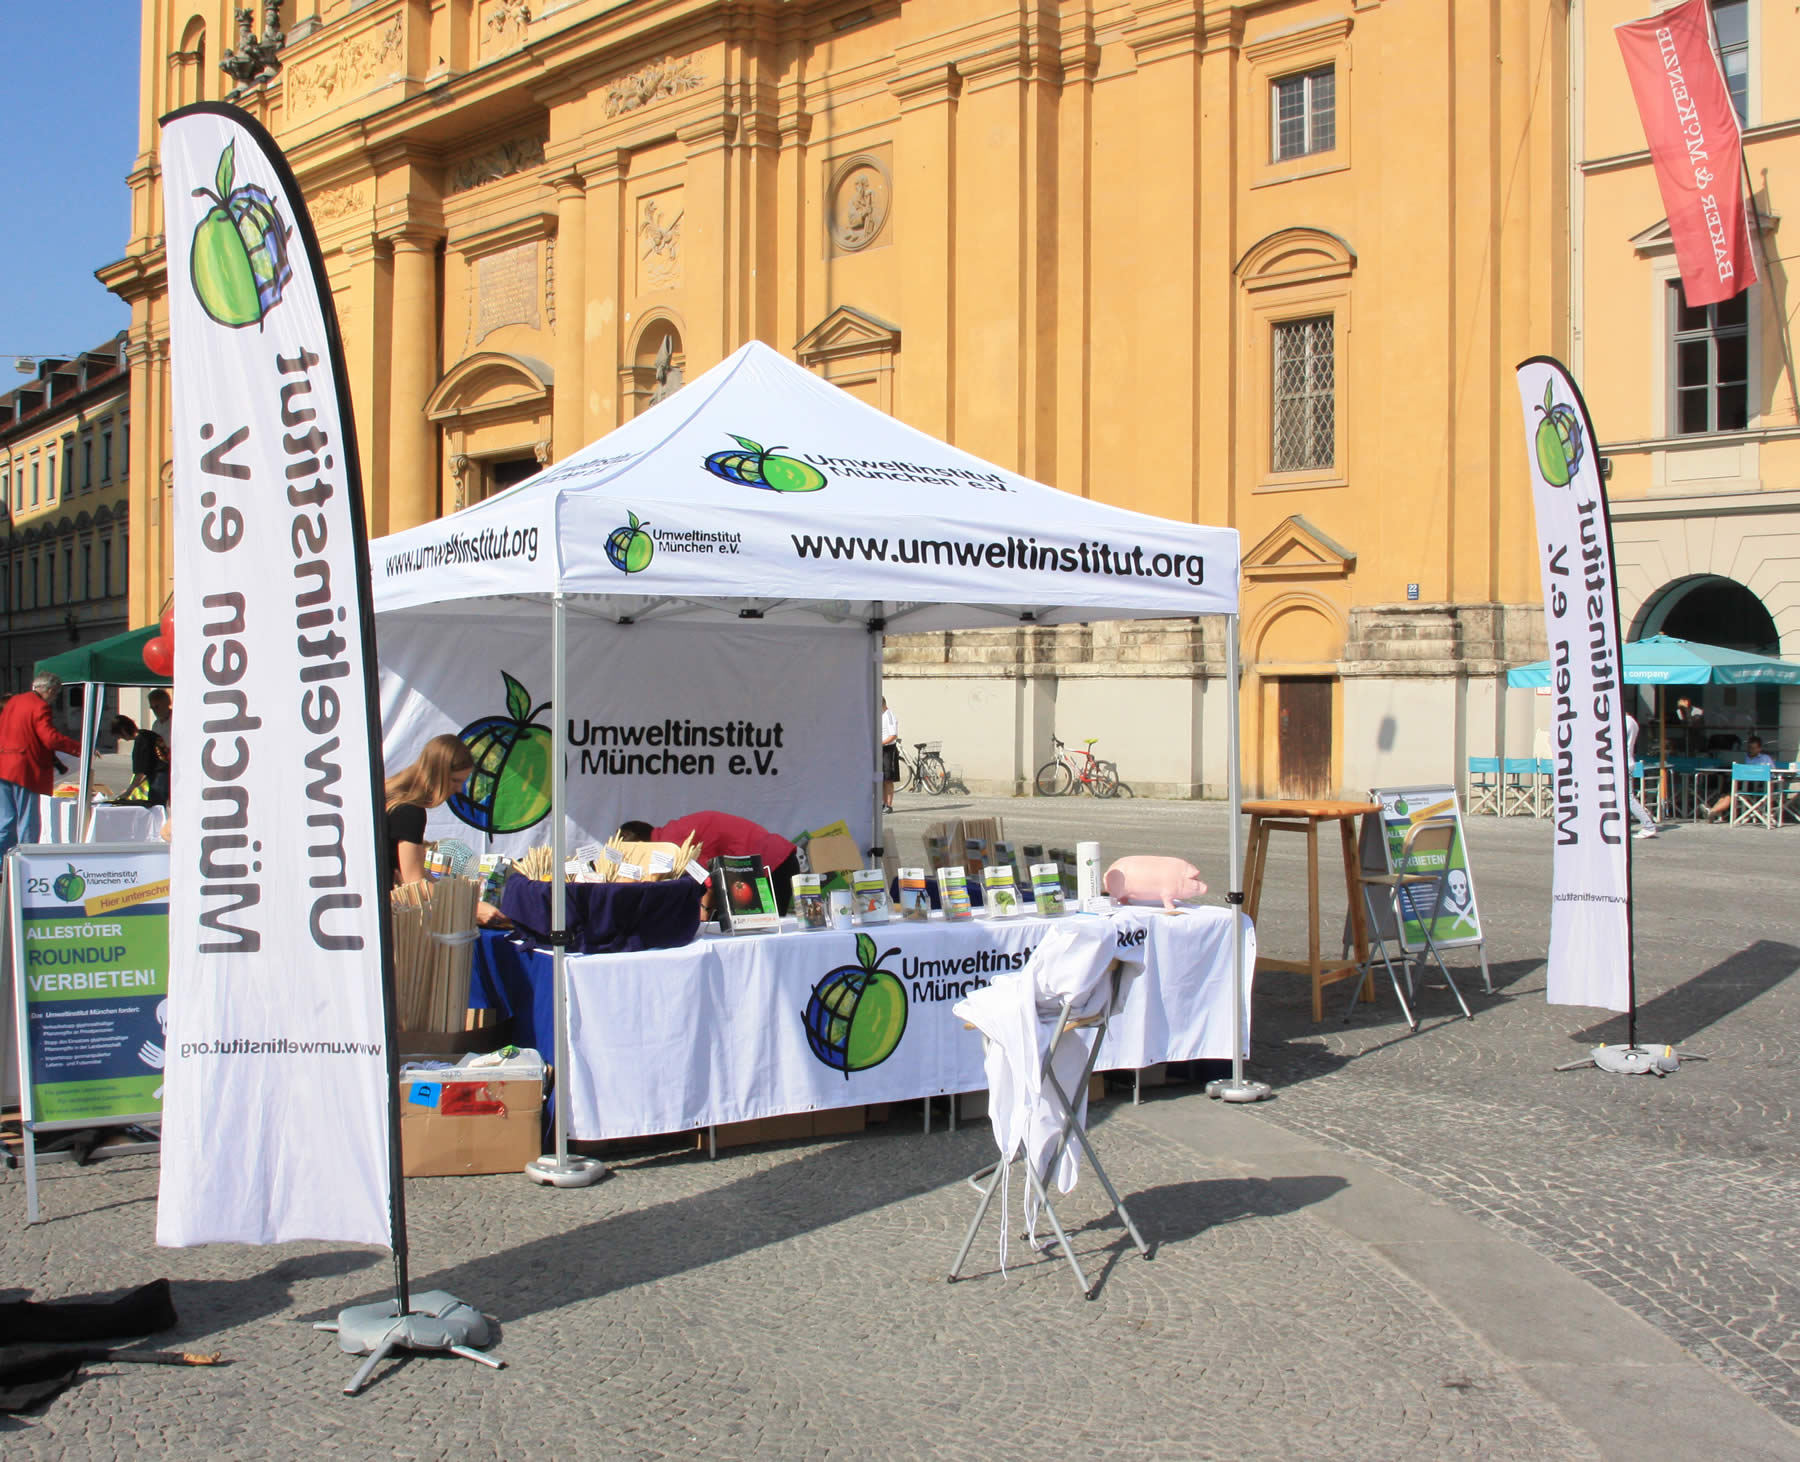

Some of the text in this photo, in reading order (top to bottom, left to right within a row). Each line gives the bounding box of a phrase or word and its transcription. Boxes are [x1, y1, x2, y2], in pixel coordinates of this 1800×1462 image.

[803, 453, 1007, 483] Umweltinstitut
[829, 466, 1017, 493] München e.V.
[652, 529, 742, 543] Umweltinstitut
[385, 525, 538, 577] www.umweltinstitut.org
[658, 541, 740, 554] München e.V.
[791, 534, 1204, 585] www.umweltinstitut.org
[1409, 584, 1418, 592] 22
[567, 719, 784, 748] Umweltinstitut
[581, 748, 778, 776] München e.V.
[82, 871, 138, 879] Umweltinstitut
[86, 877, 121, 885] München
[27, 878, 49, 893] 25
[100, 897, 120, 909] Hier
[27, 922, 122, 940] ALLESTÖTER
[29, 946, 127, 966] ROUNDUP
[29, 969, 156, 992] VERBIETEN!
[912, 975, 992, 1003] Münch
[45, 1010, 88, 1018] Umweltinstitut
[89, 1008, 117, 1016] München
